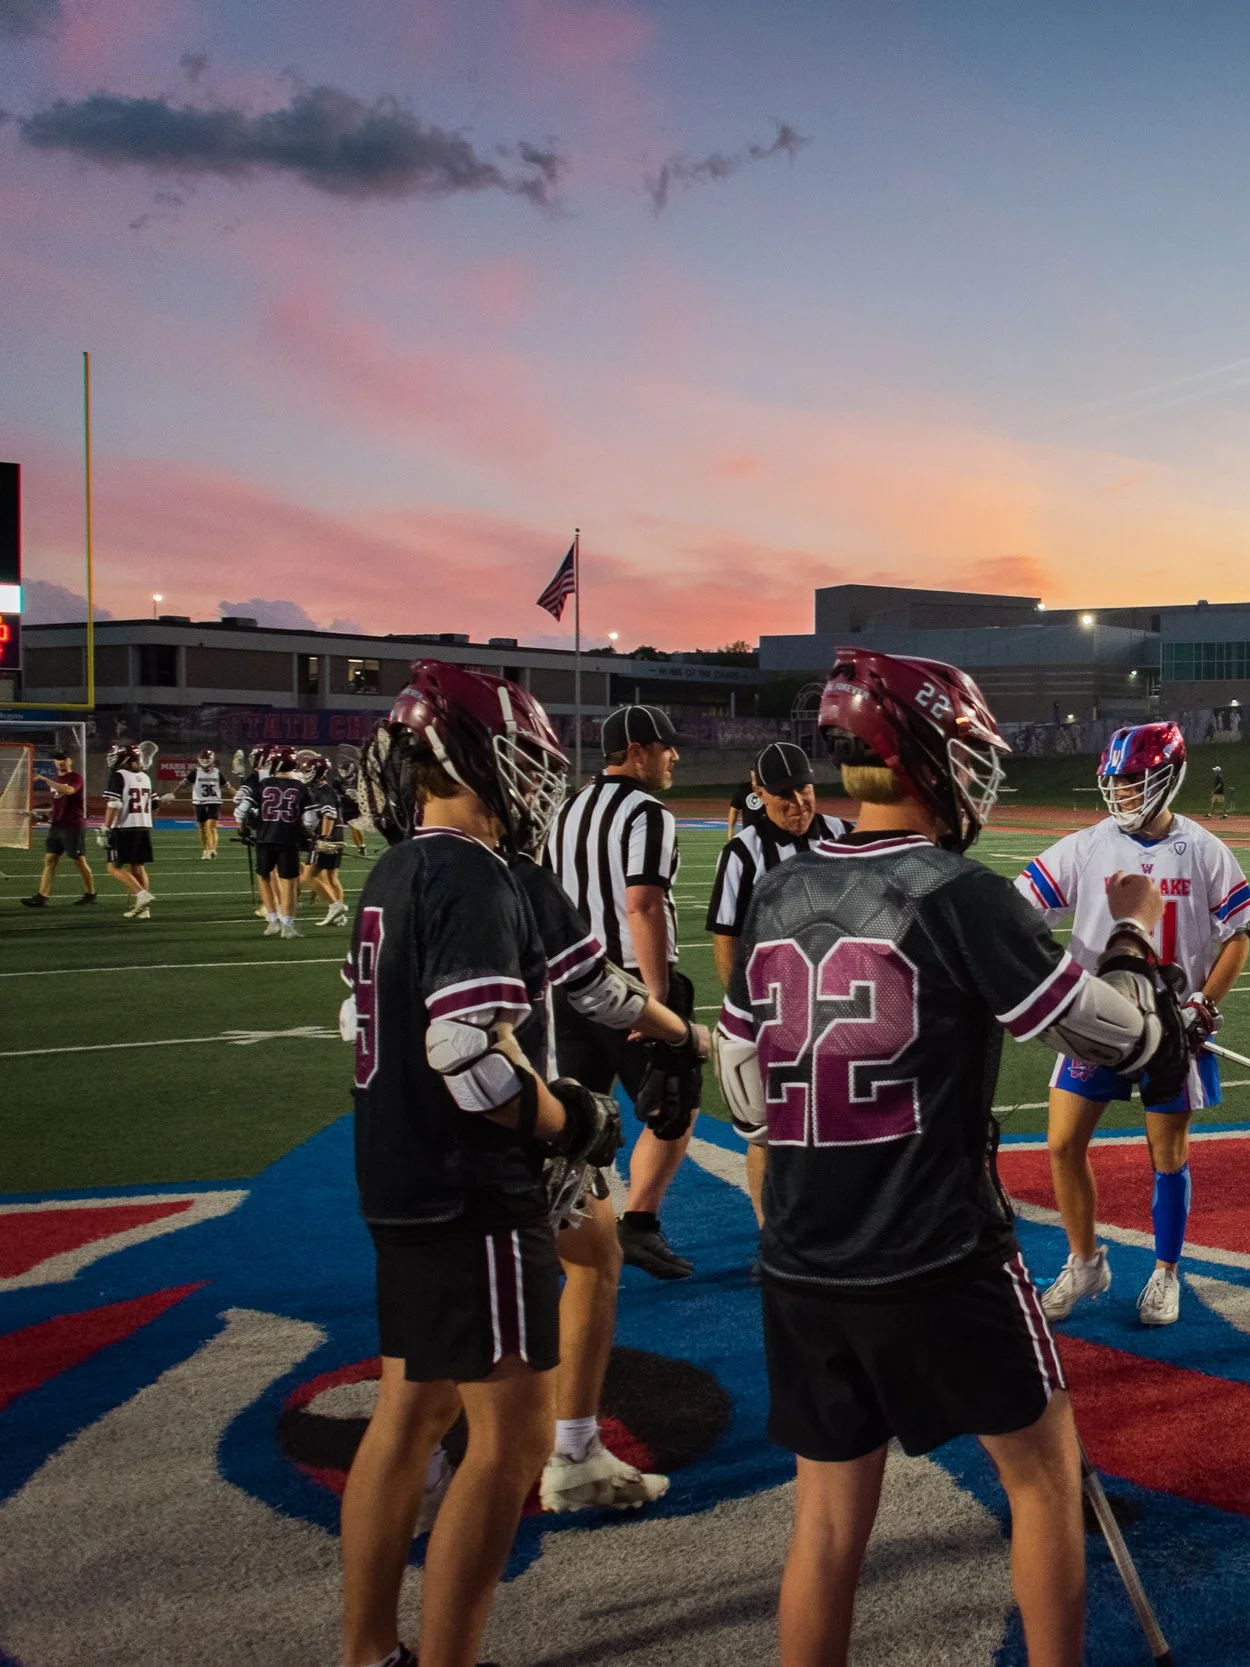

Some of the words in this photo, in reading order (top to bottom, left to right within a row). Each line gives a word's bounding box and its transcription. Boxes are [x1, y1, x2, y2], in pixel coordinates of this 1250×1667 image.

[914, 681, 955, 720] 22
[226, 713, 319, 740] STATE
[128, 788, 151, 814] 27
[262, 786, 300, 823] 23
[745, 936, 922, 1148] 22
